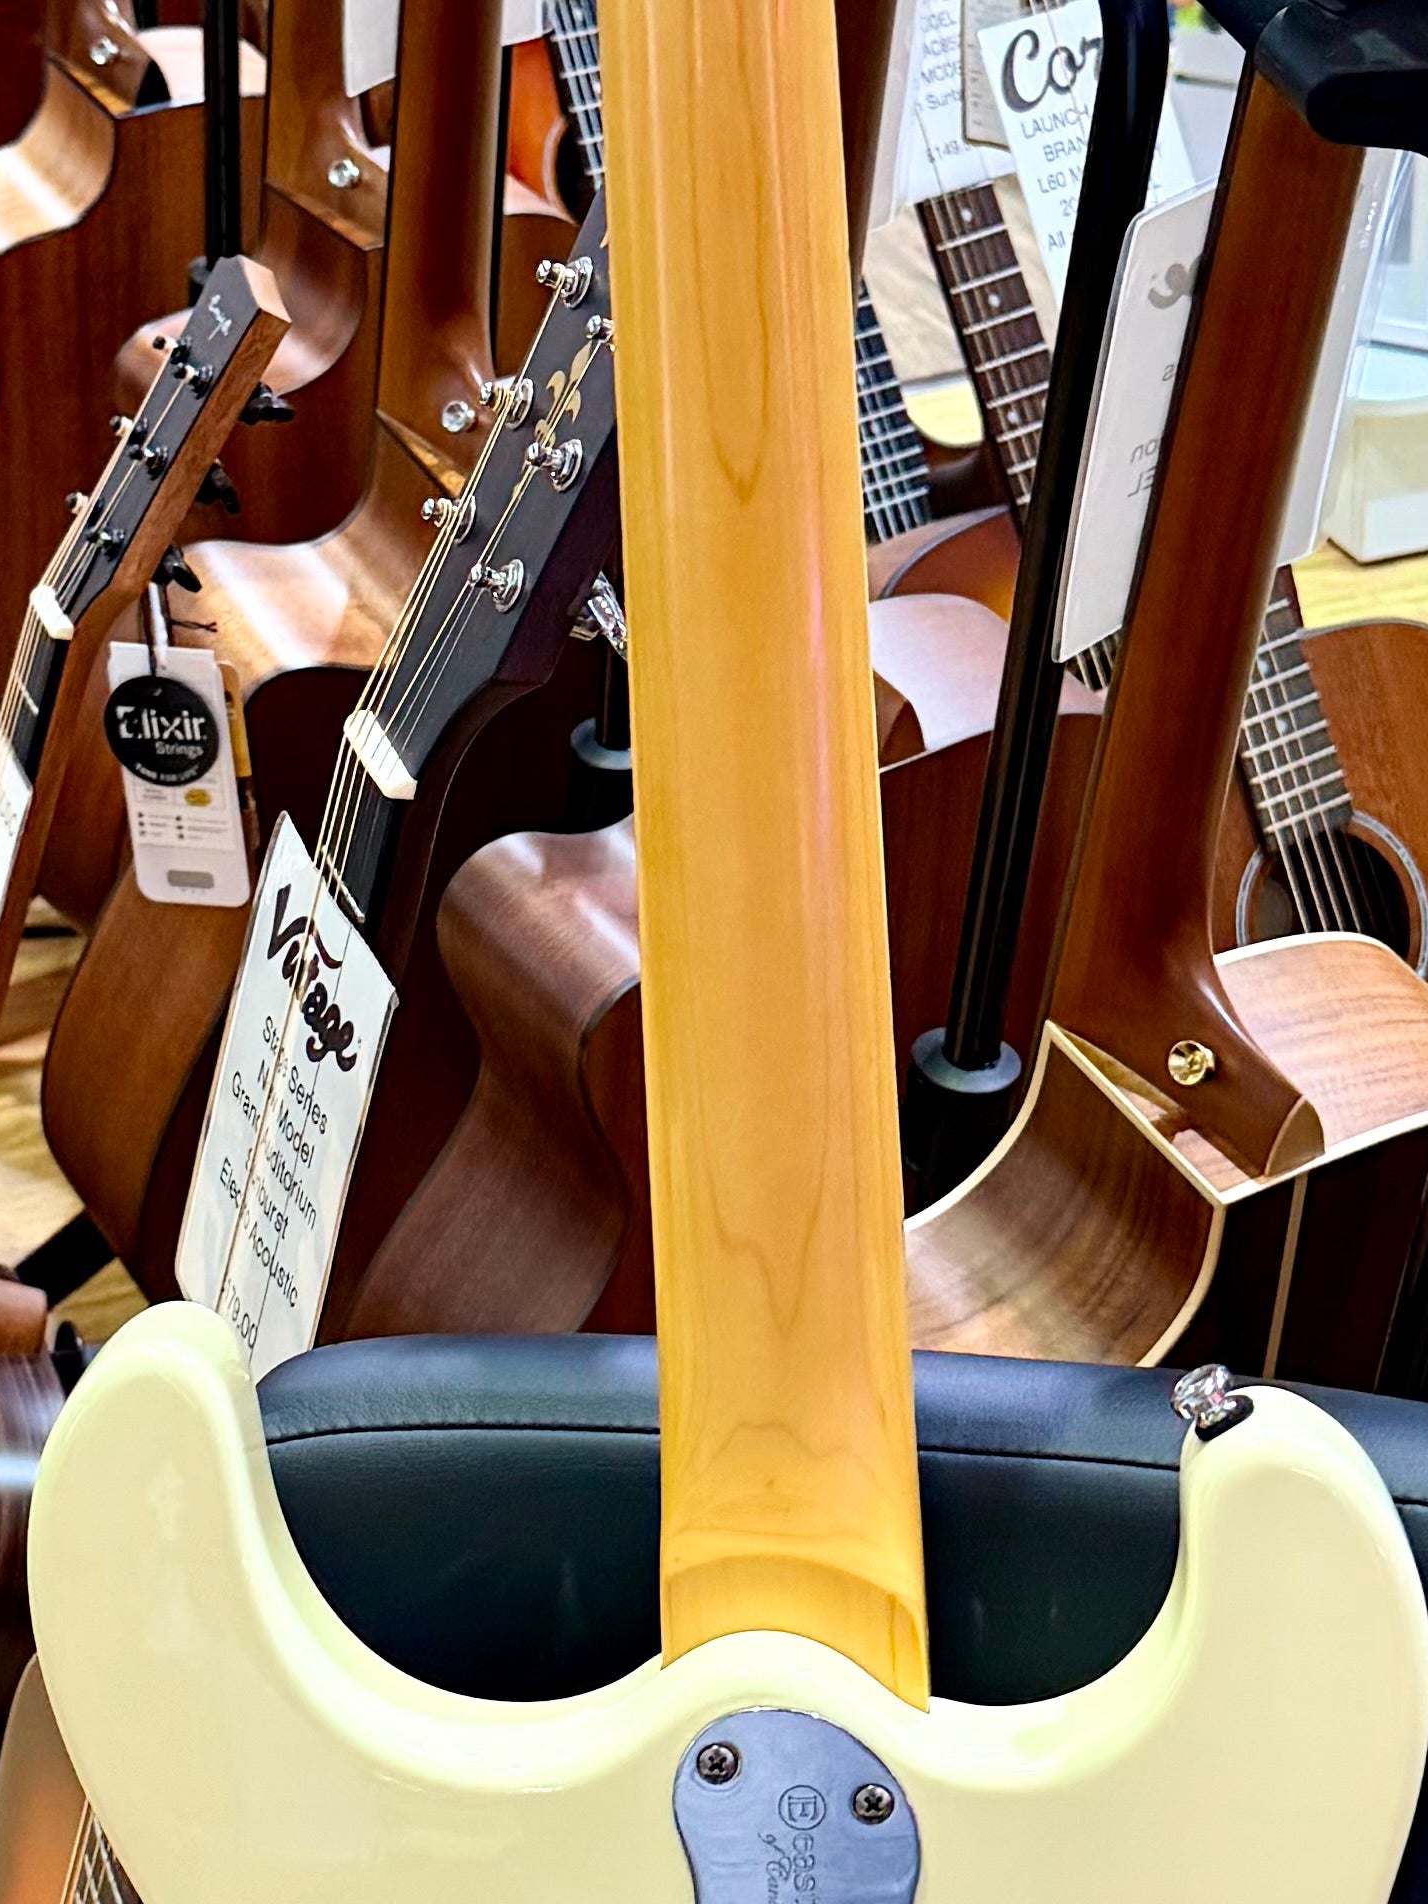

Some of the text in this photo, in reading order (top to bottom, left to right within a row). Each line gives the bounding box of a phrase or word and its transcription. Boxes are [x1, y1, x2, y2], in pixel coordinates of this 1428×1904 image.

[116, 704, 207, 740] Elixir
[155, 741, 204, 758] Strings
[248, 1221, 298, 1308] Acoustic
